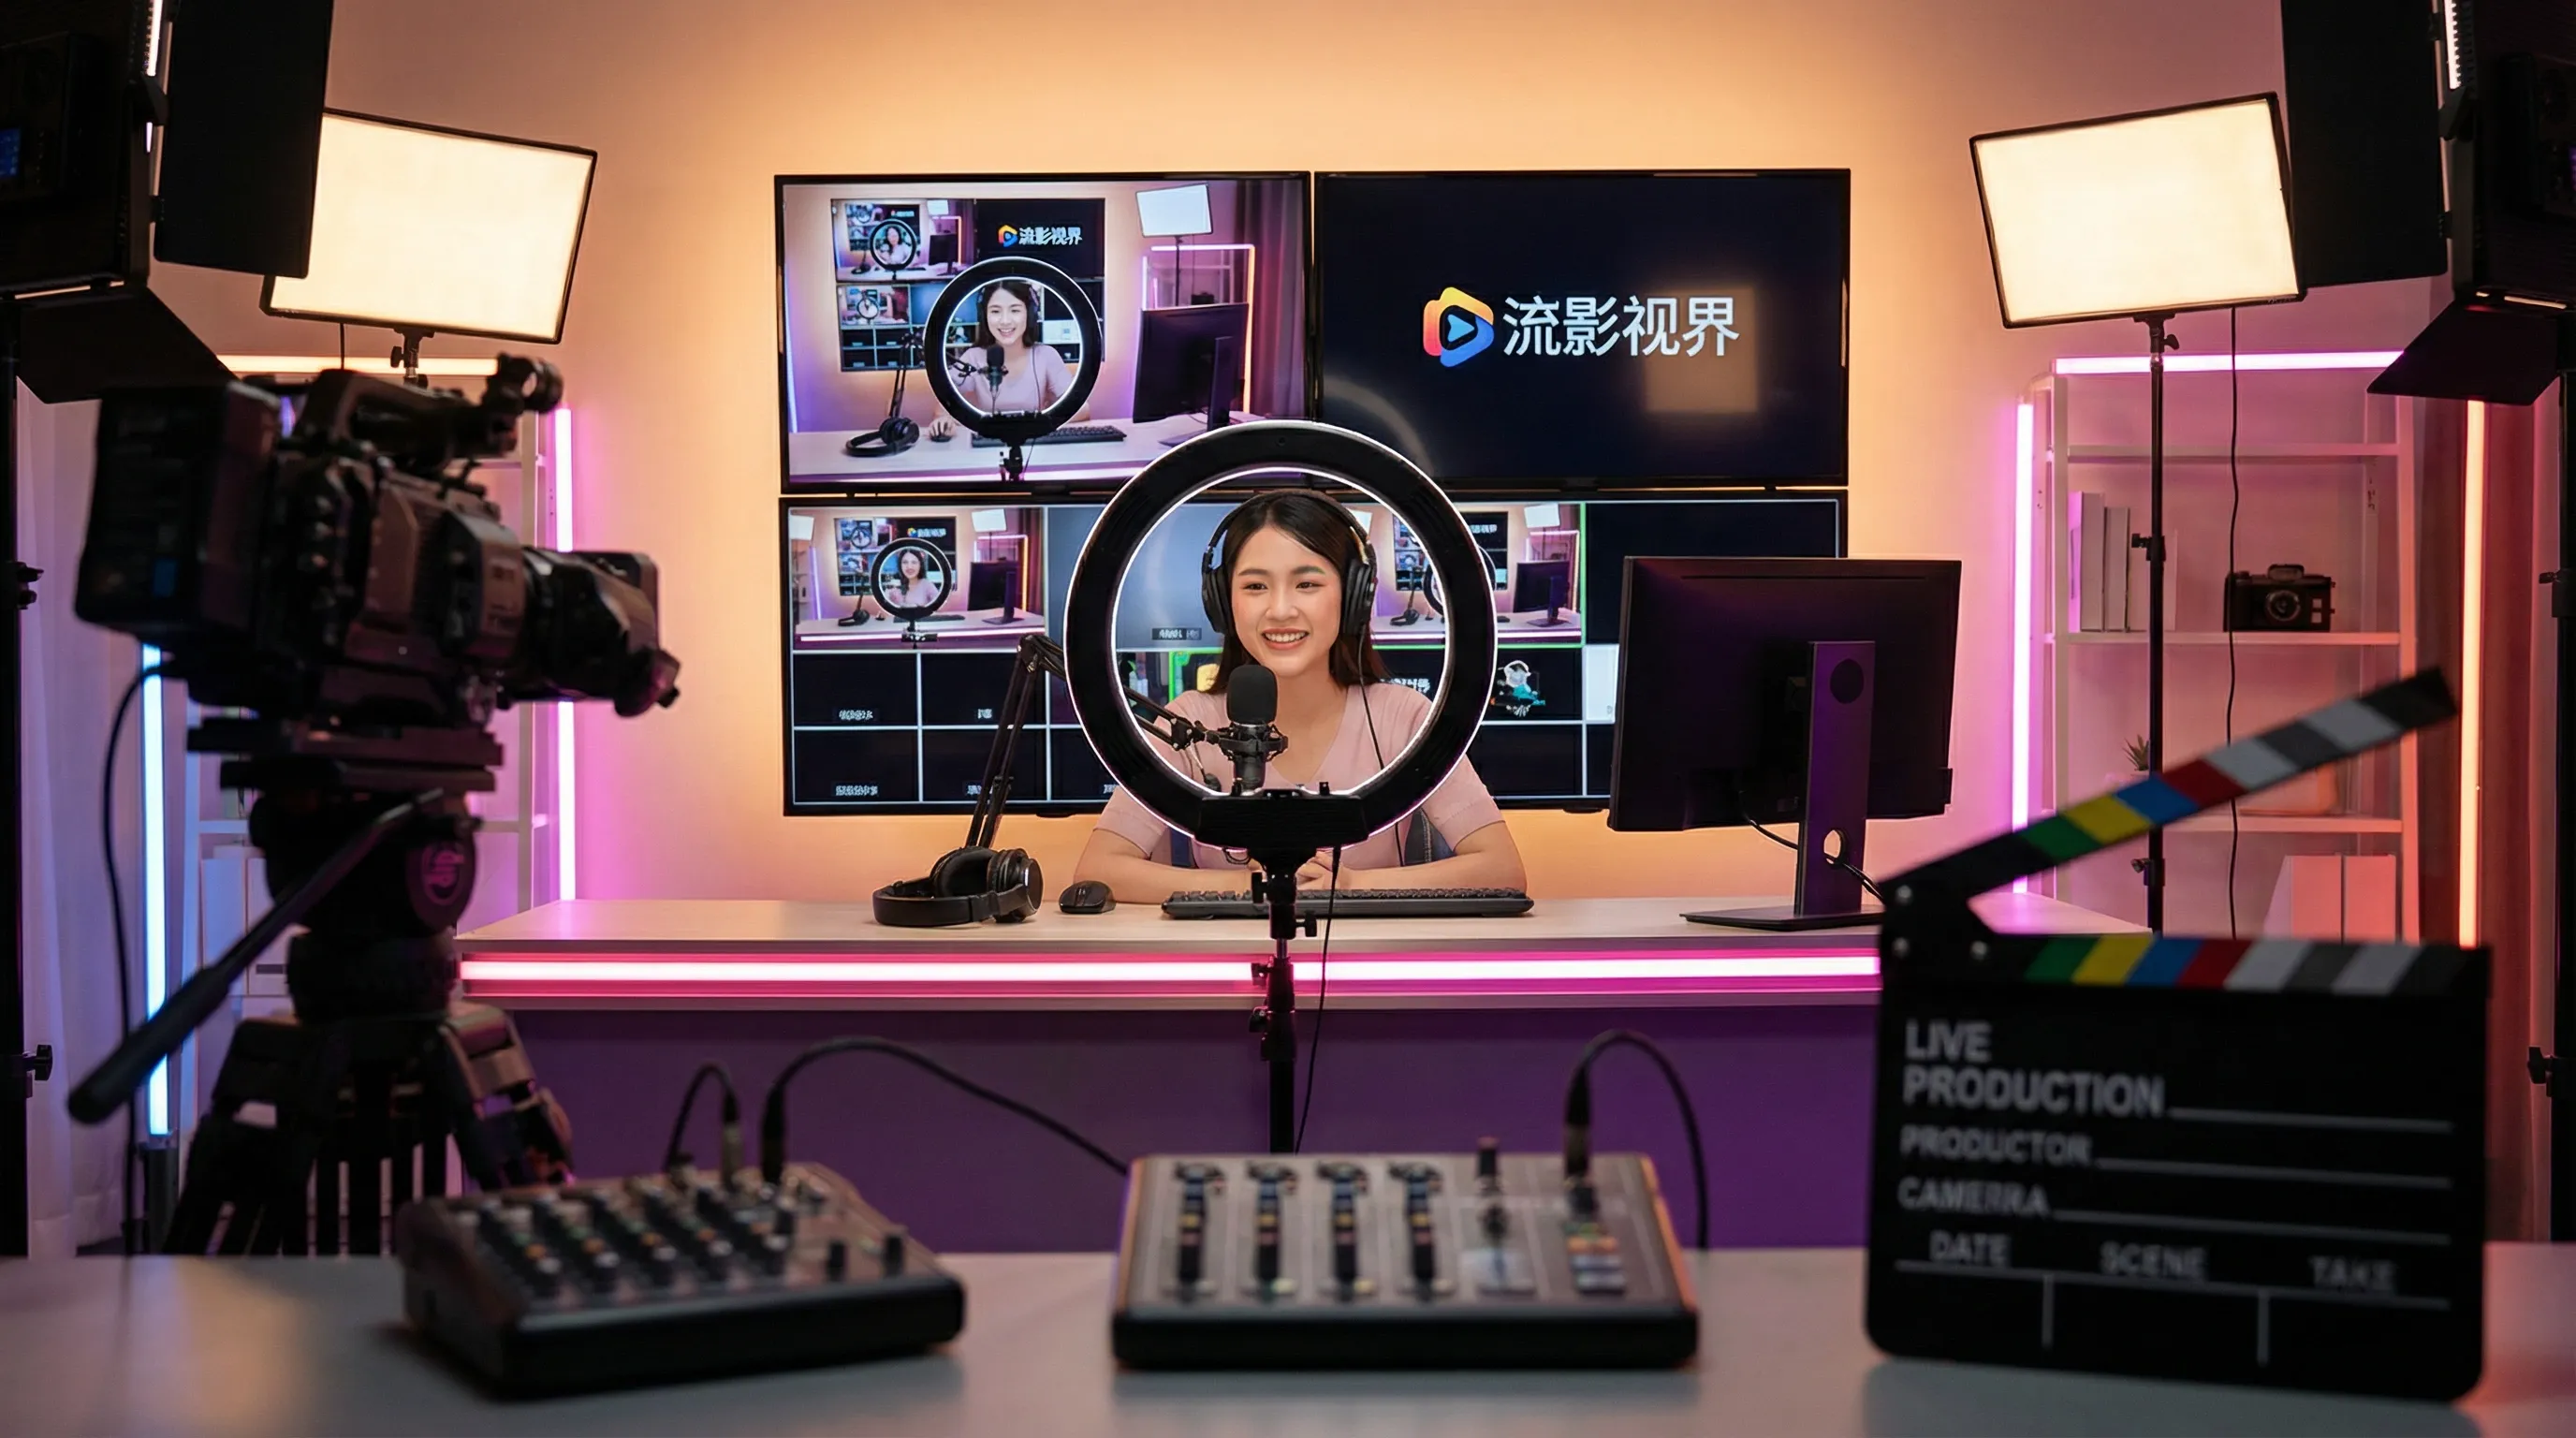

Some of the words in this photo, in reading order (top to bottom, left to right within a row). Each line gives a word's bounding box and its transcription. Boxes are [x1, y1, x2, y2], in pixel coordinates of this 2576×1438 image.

[1502, 295, 1740, 358] 流影视界
[1904, 1019, 1993, 1064] LIVE
[1902, 1064, 2165, 1119] PRODUCTION
[1927, 1229, 2012, 1267] DATE
[2099, 1240, 2209, 1280] SCENE
[2307, 1255, 2398, 1291] TAKE
